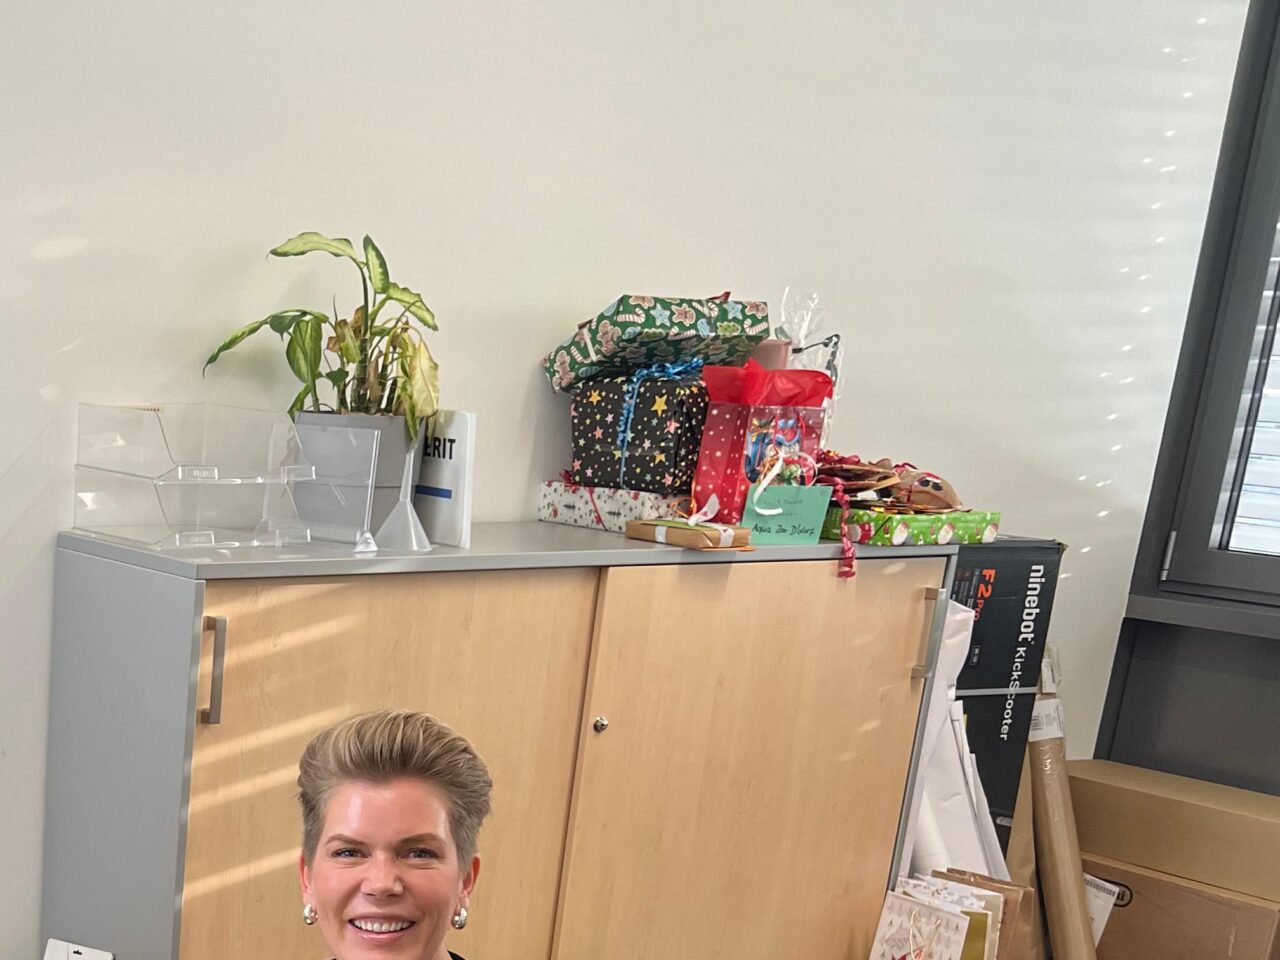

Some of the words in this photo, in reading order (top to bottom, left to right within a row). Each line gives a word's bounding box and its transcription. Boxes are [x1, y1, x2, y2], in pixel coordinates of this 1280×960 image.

[977, 568, 997, 598] F2
[1018, 565, 1046, 642] ninebot
[999, 646, 1027, 741] KickScooter
